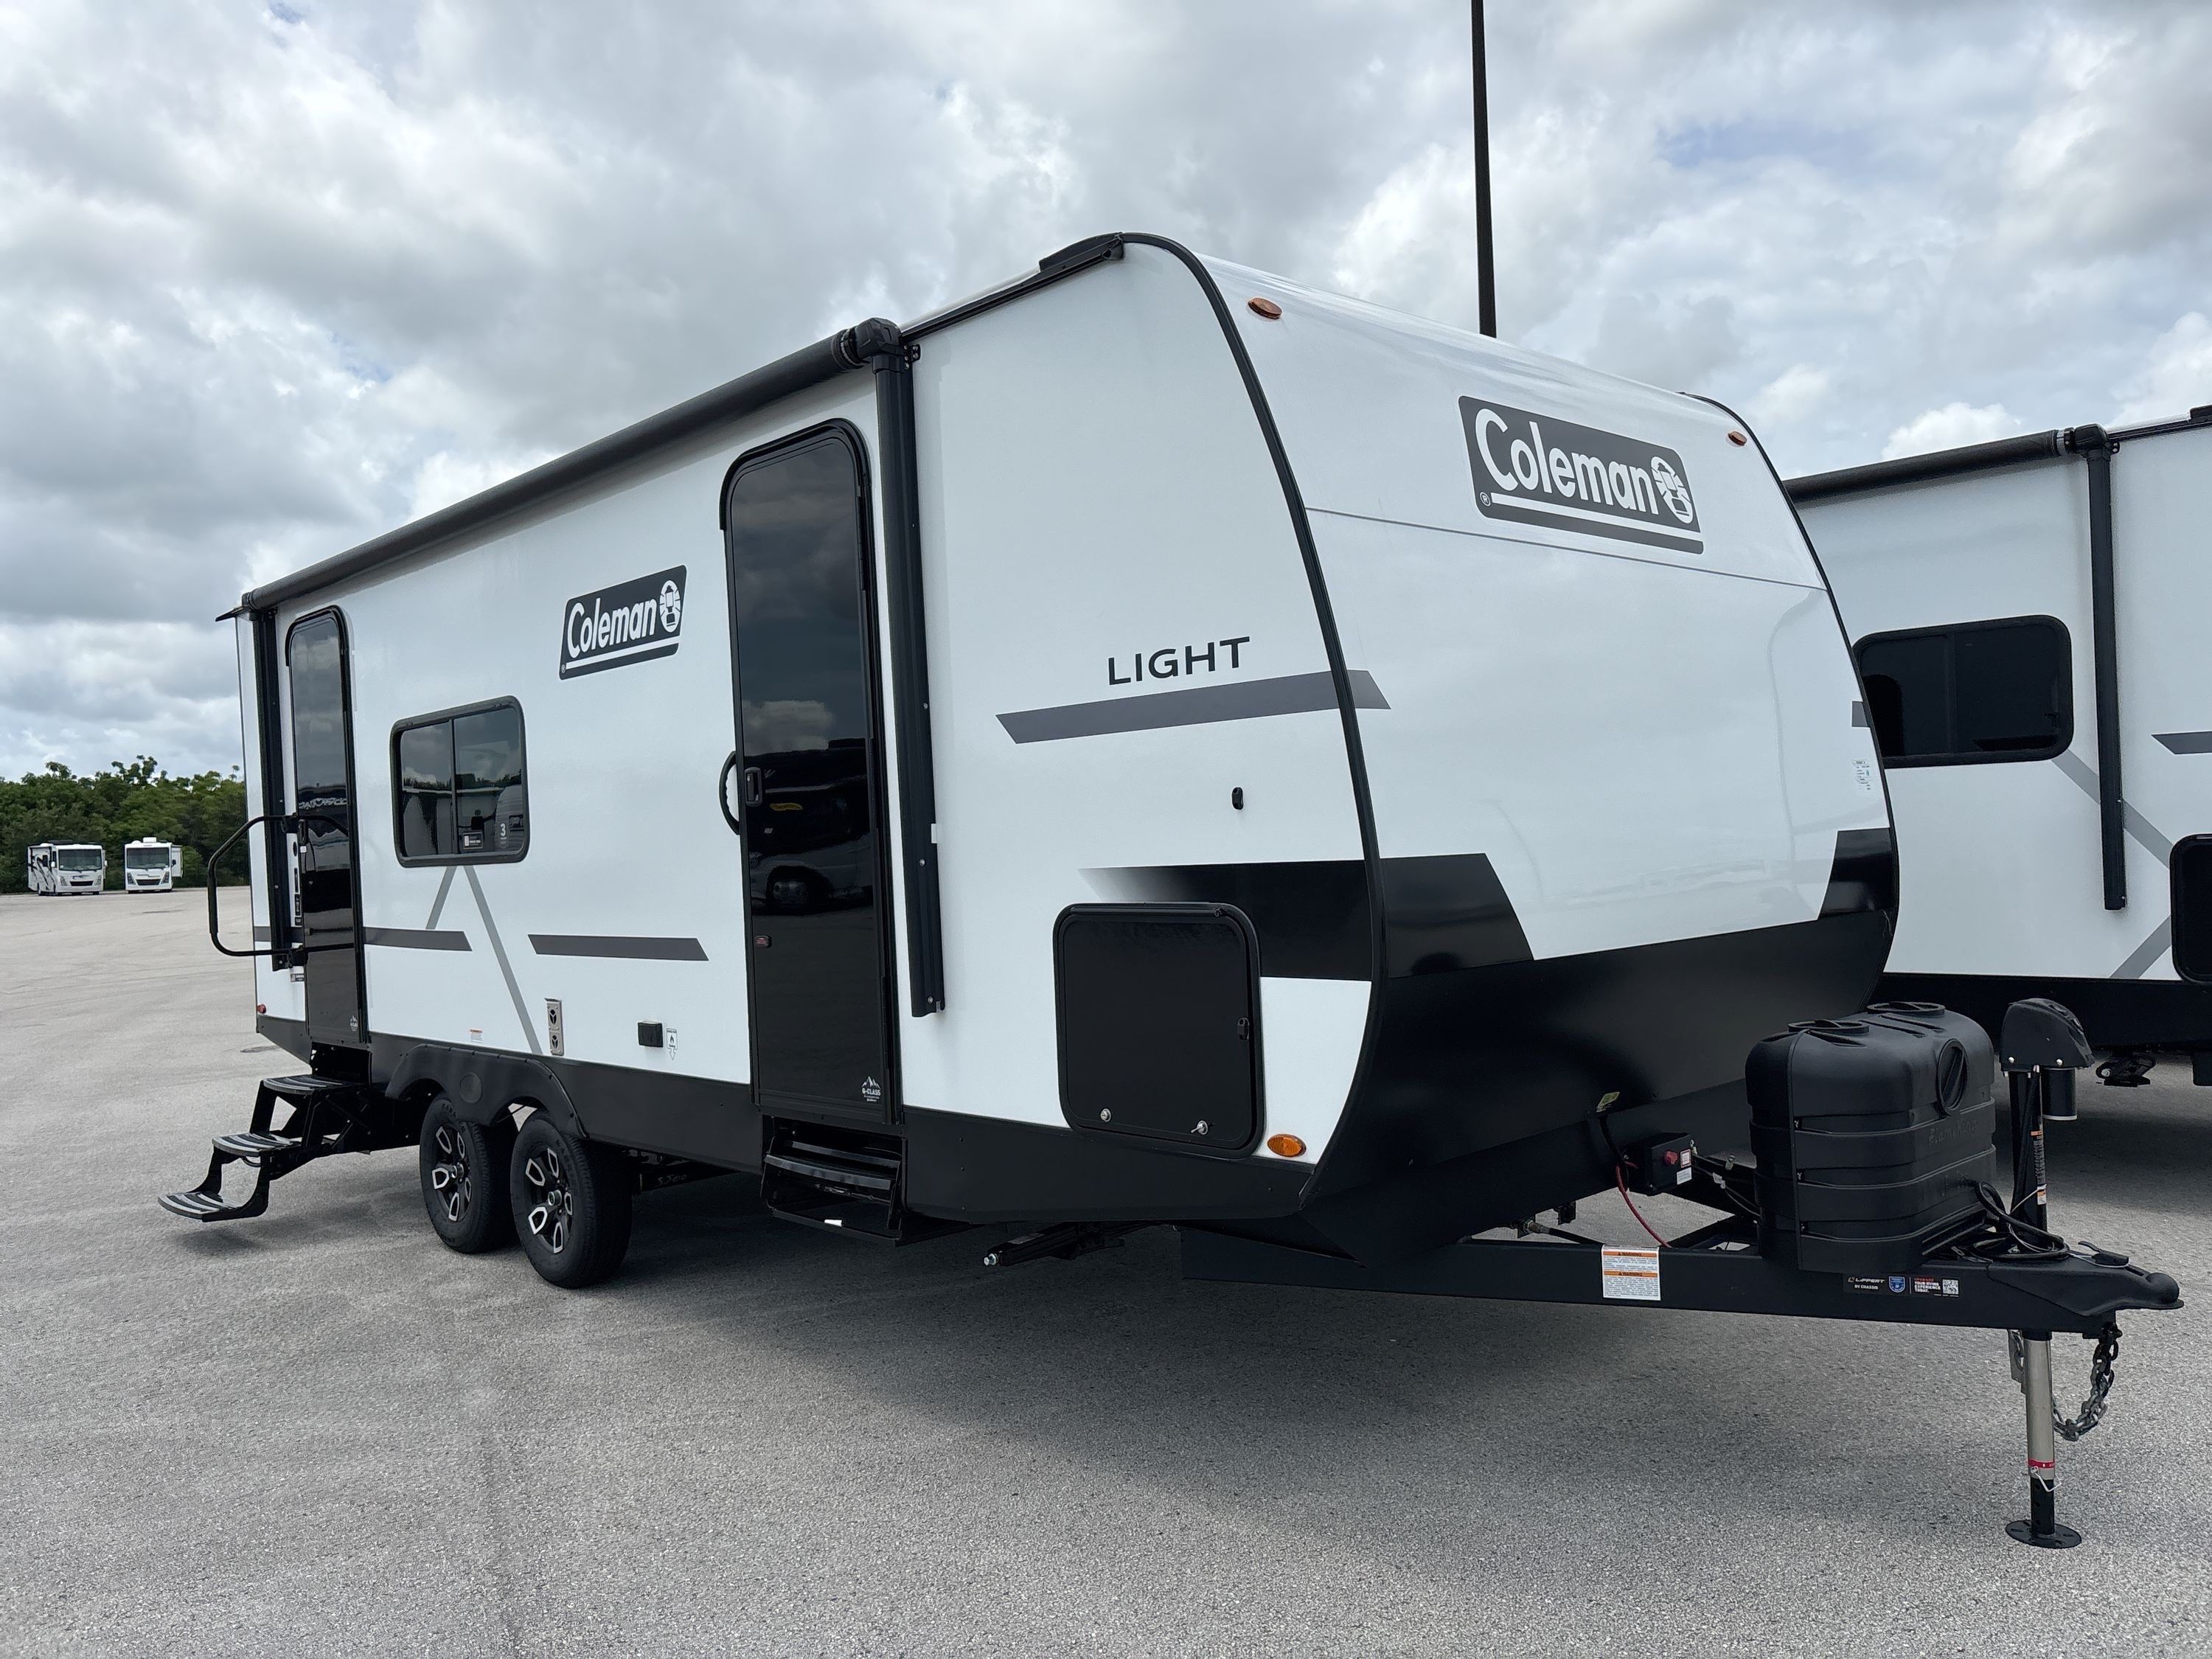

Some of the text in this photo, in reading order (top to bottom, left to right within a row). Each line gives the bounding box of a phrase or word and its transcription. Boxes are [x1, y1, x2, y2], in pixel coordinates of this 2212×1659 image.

[1475, 408, 1659, 515] Coleman
[567, 597, 658, 658] Coleman
[1107, 636, 1251, 686] LIGHT
[500, 822, 507, 837] 3
